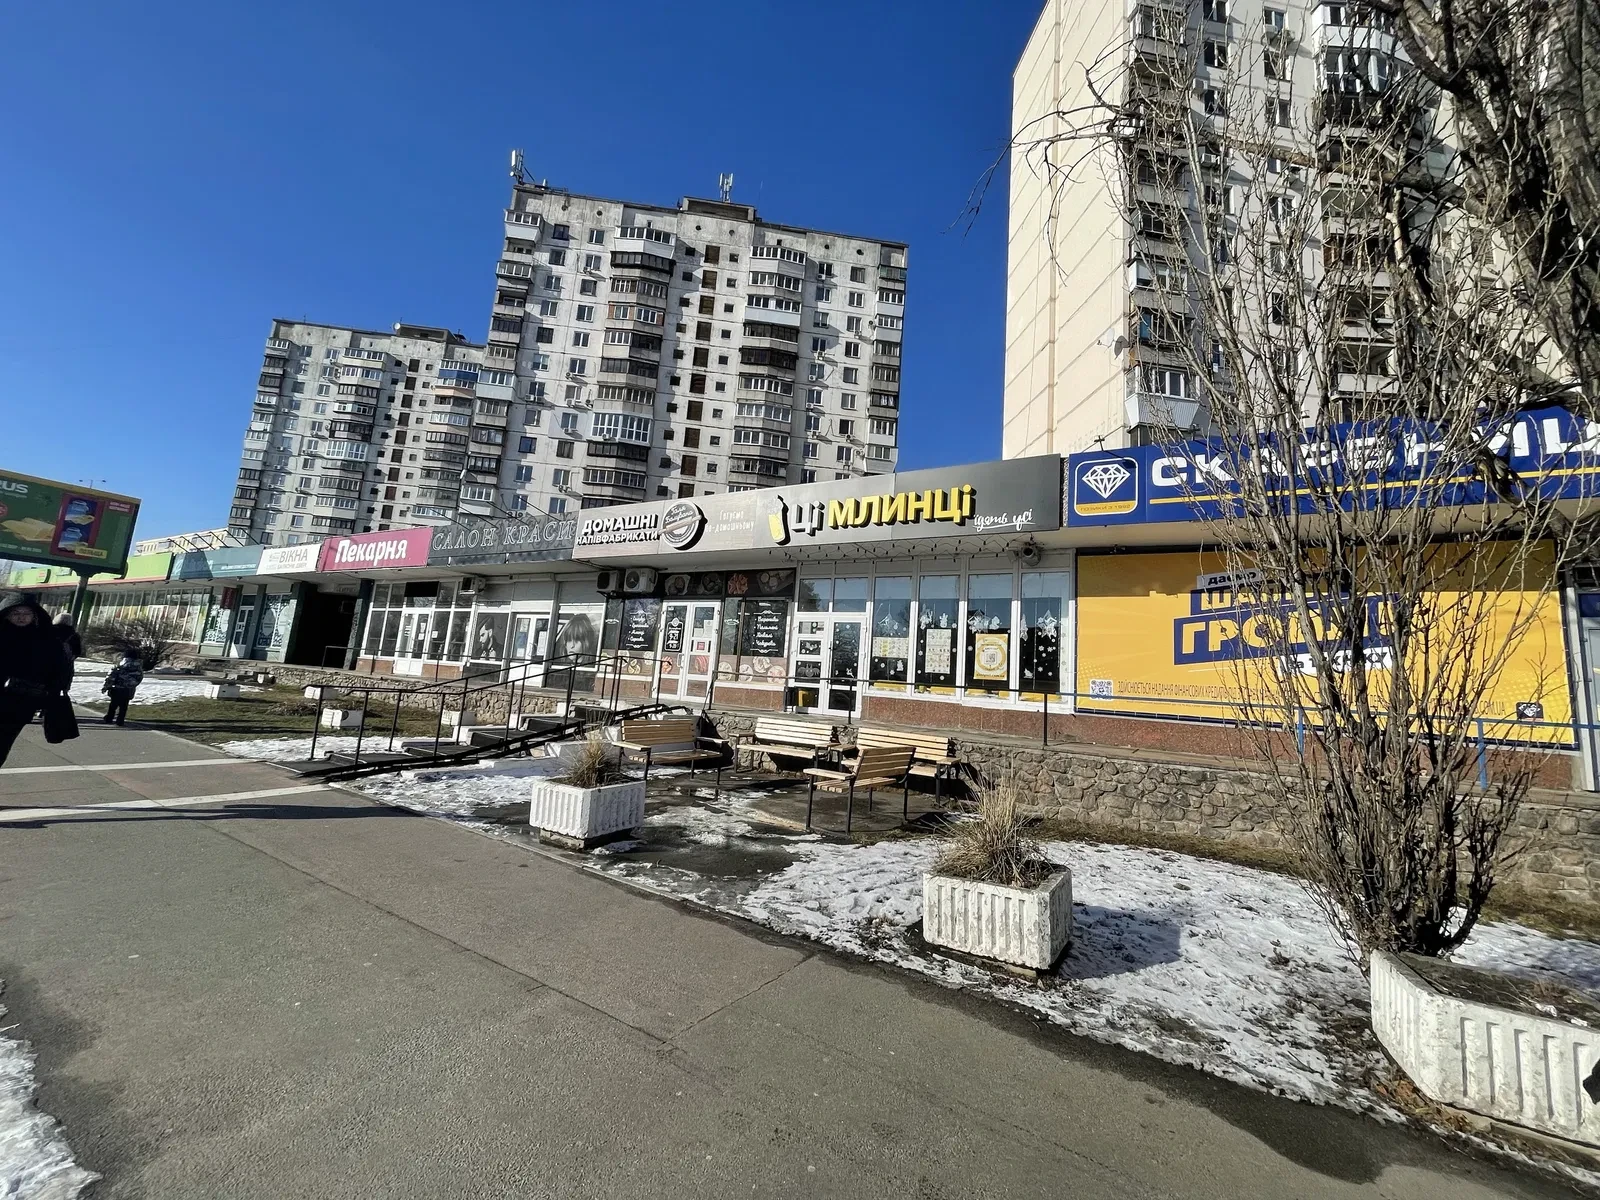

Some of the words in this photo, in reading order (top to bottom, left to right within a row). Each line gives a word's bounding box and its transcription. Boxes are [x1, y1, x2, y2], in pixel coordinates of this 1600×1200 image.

[0, 480, 29, 494] US
[582, 514, 656, 535] ДОМАШНІ
[1013, 509, 1033, 531] усі
[432, 528, 496, 551] САЛОН
[503, 520, 575, 545] КРАСИ
[577, 531, 658, 545] НАПІВФАБРИКАТИ
[279, 549, 308, 563] ВІКНА
[335, 539, 408, 563] Пекарня
